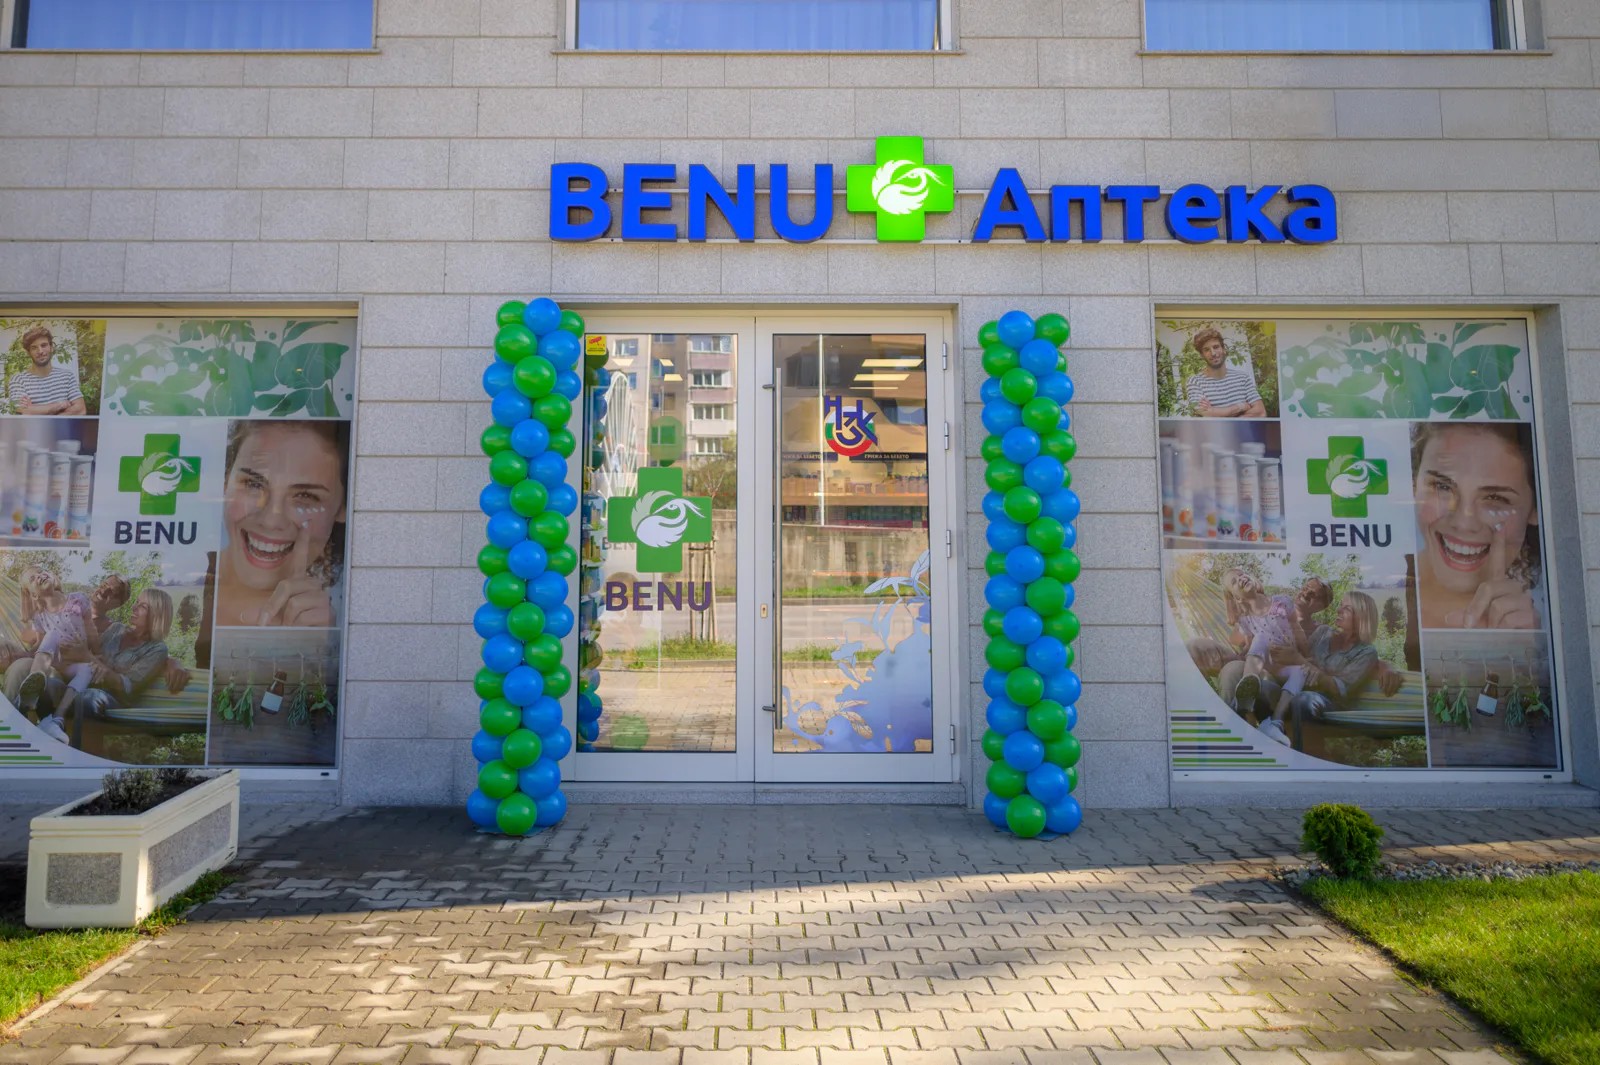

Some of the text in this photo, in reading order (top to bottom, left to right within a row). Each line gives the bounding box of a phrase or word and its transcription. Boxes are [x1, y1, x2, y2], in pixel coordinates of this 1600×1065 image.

[550, 162, 833, 242] BENU
[974, 168, 1338, 244] Аптека
[114, 521, 197, 544] BENU
[1310, 523, 1392, 547] BENU
[606, 582, 712, 611] BENU
